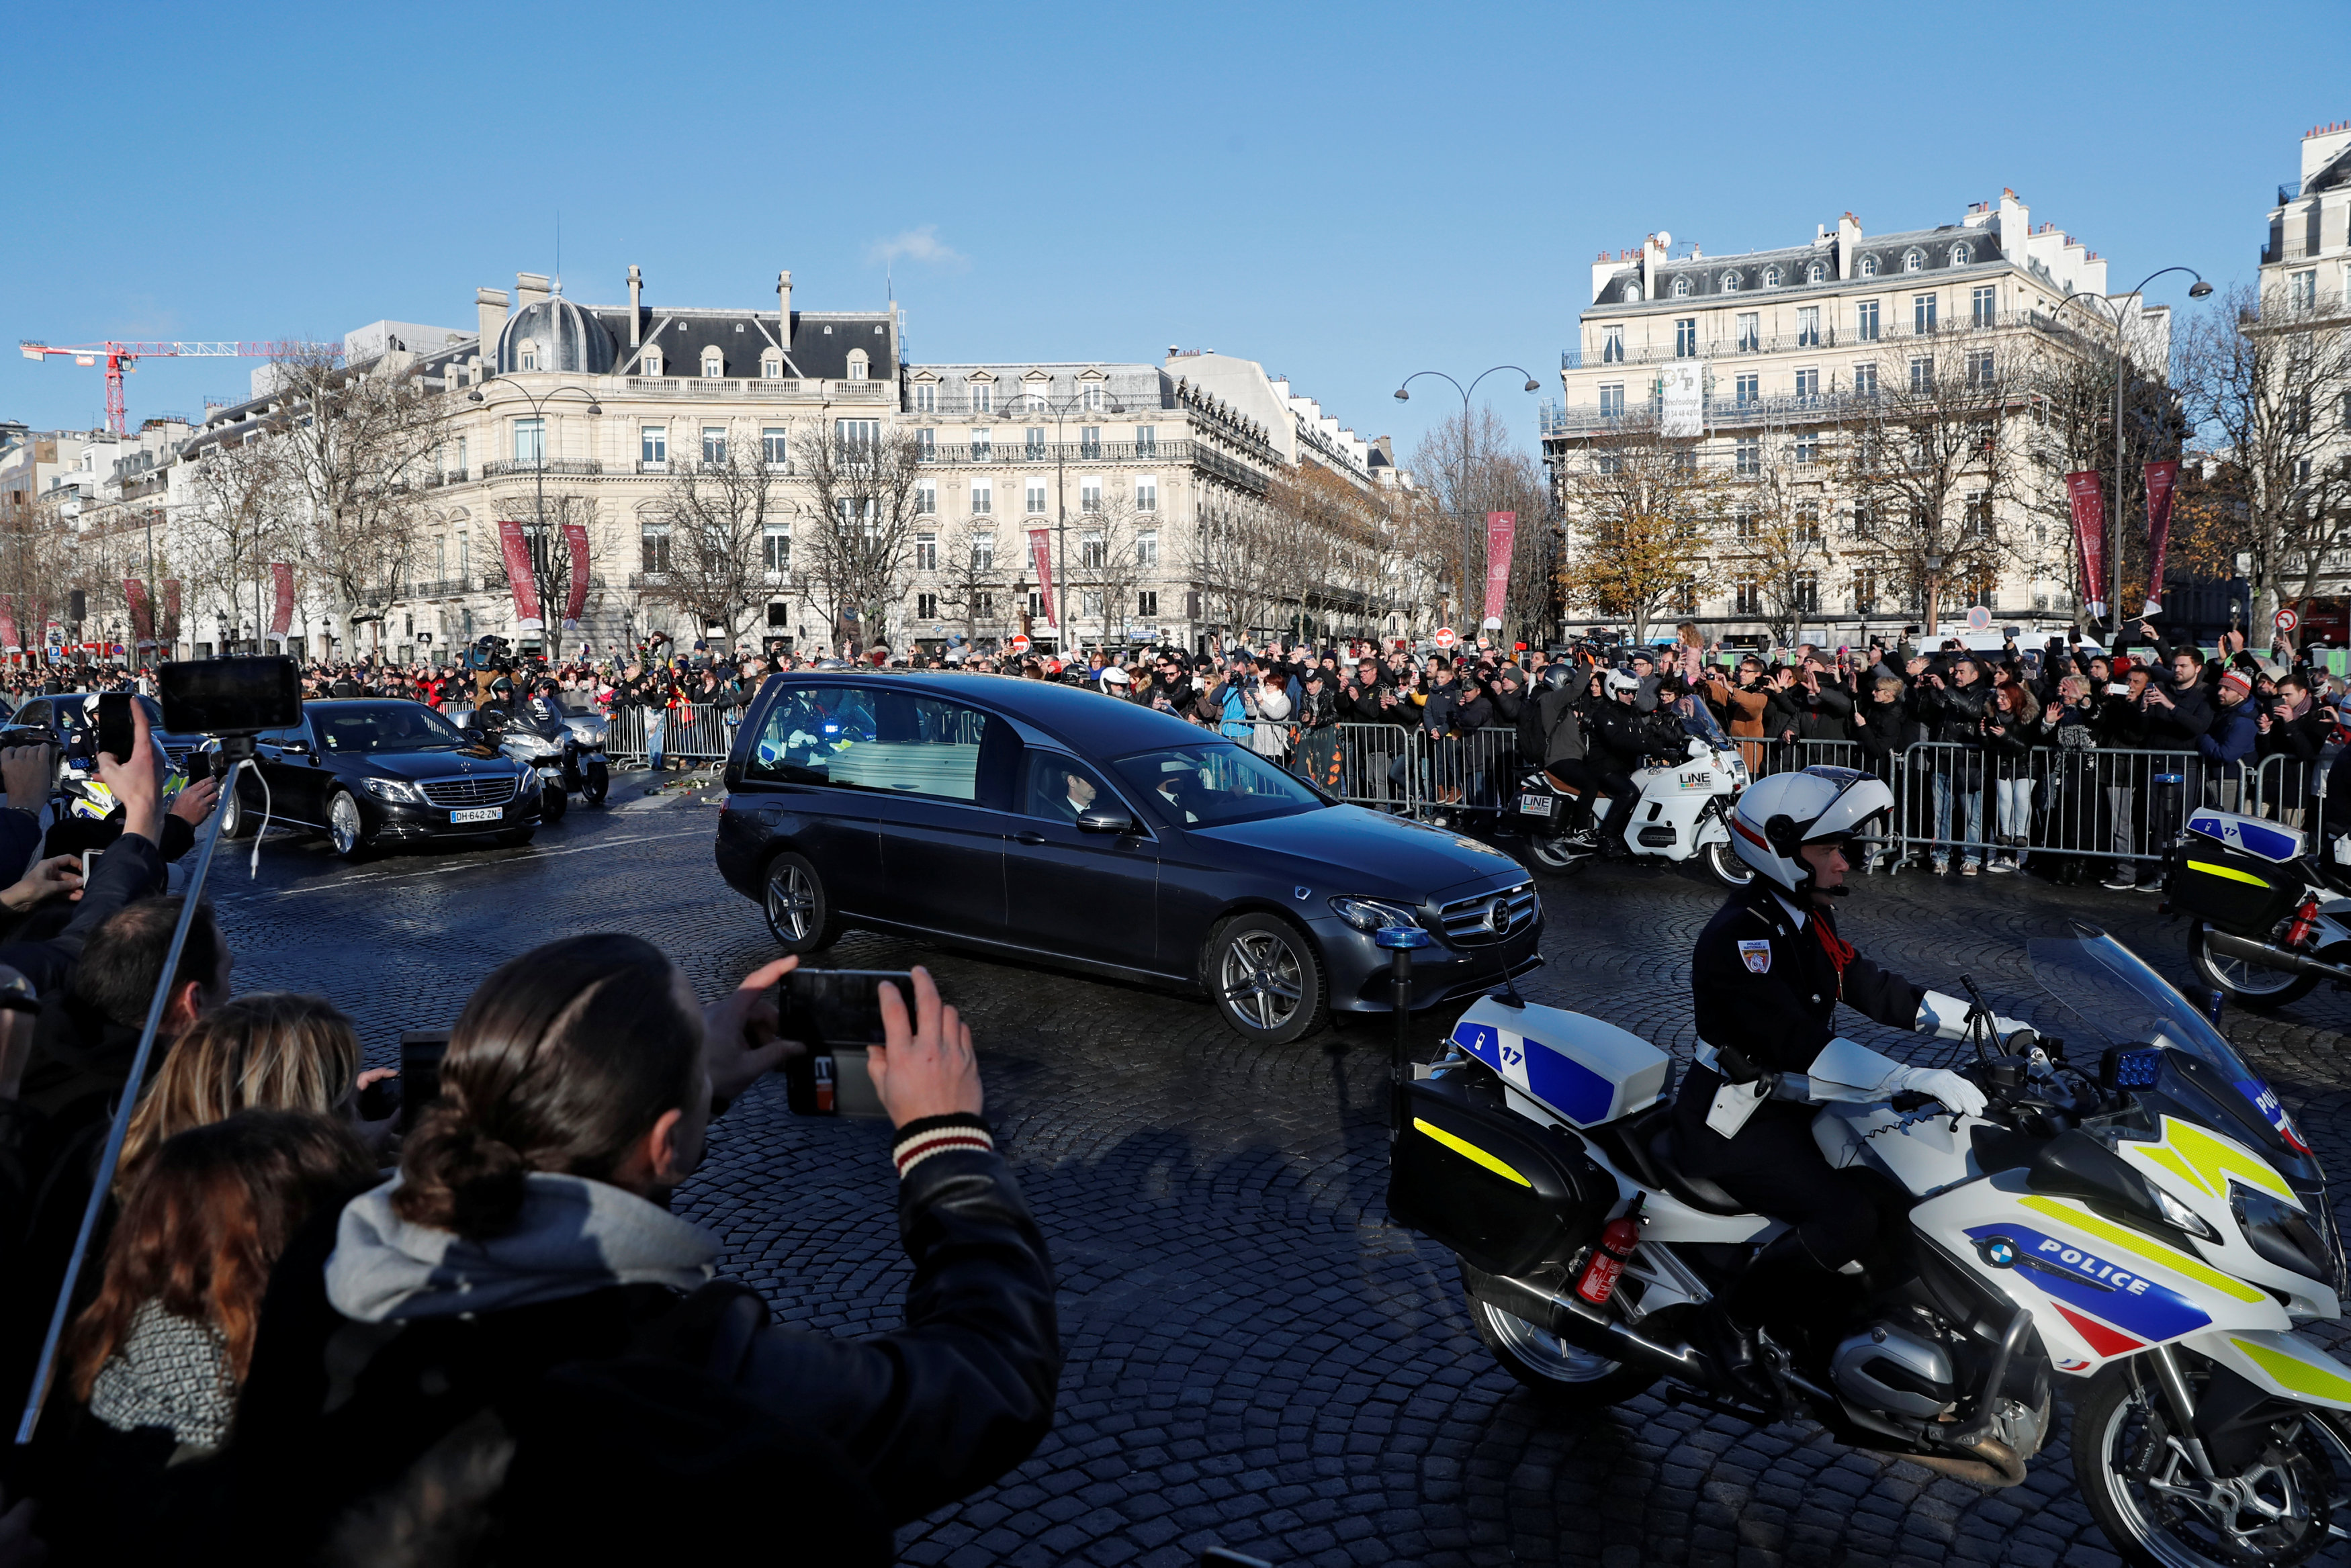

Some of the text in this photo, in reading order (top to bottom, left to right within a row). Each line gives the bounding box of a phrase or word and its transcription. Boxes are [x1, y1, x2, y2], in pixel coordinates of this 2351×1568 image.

[500, 460, 547, 471] ORLANE
[1679, 772, 1711, 783] LiNE
[1523, 796, 1550, 807] LiNE
[456, 809, 497, 821] DH-642-ZN
[2224, 827, 2238, 837] 17
[1503, 1046, 1523, 1066] 17
[2037, 1239, 2150, 1296] POLICE
[2137, 1442, 2156, 1472] brembo
